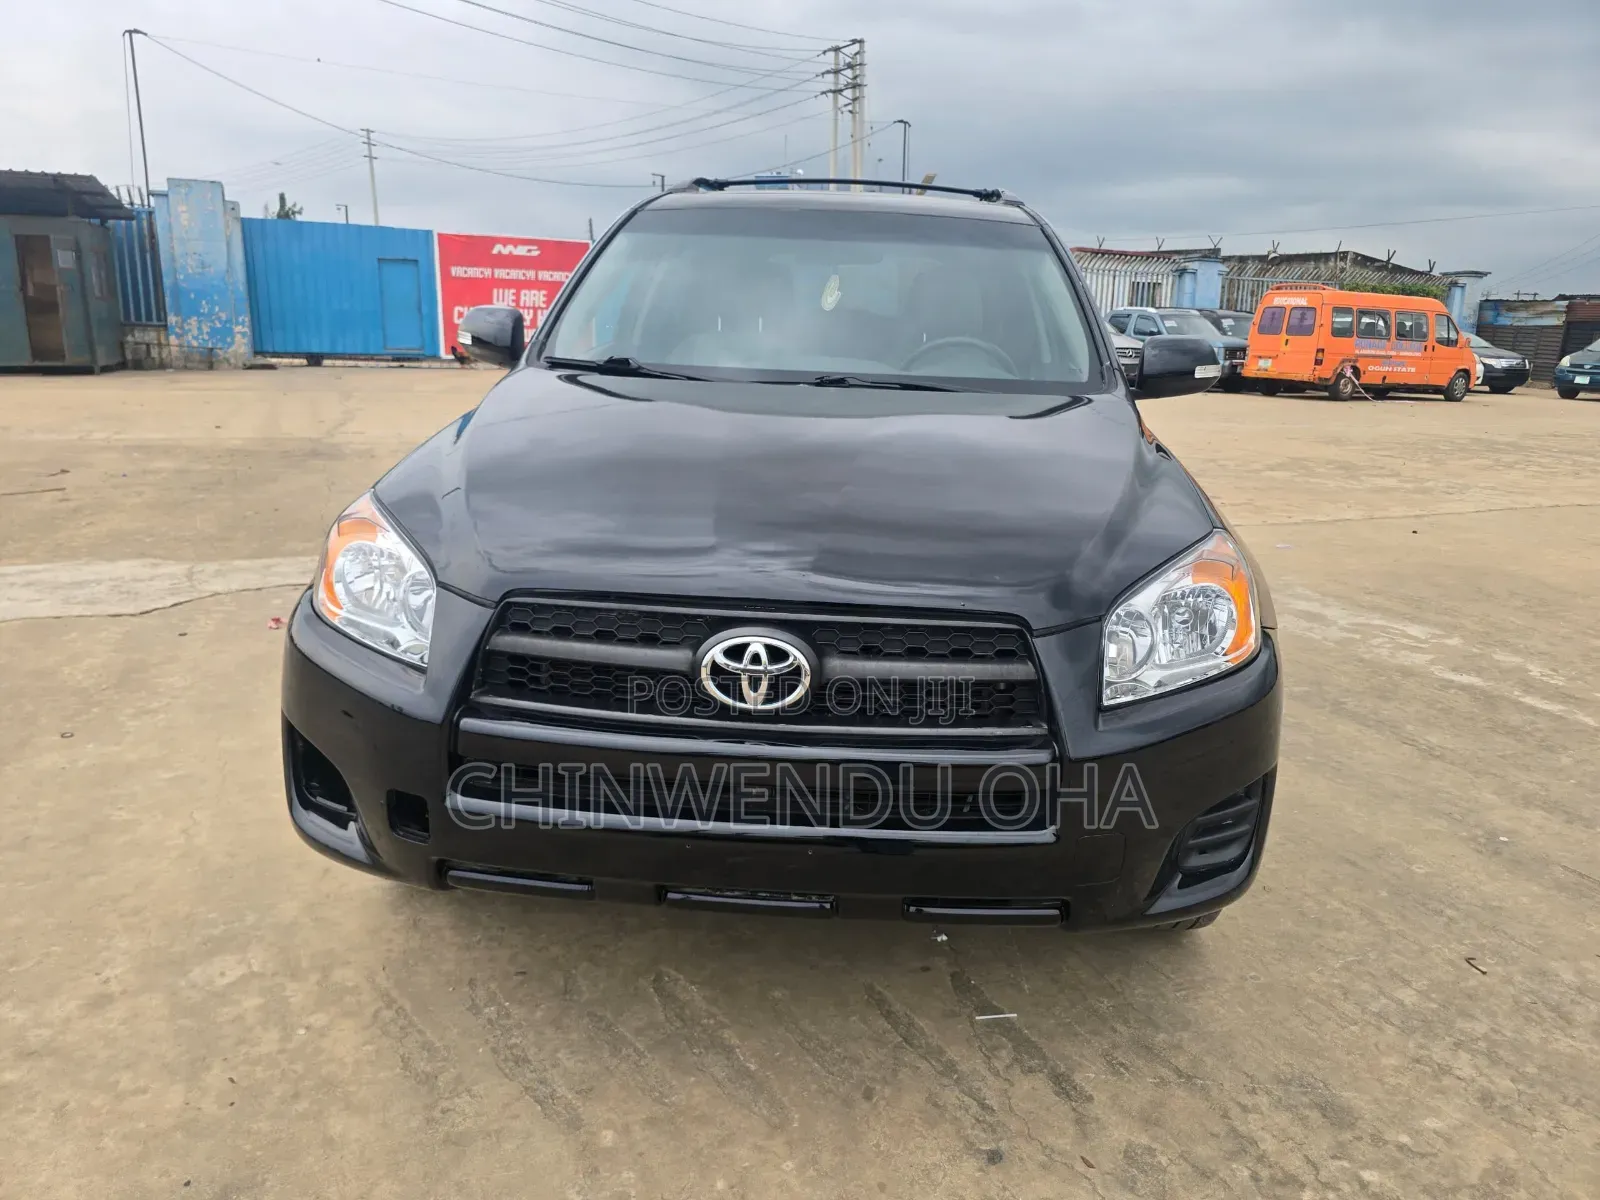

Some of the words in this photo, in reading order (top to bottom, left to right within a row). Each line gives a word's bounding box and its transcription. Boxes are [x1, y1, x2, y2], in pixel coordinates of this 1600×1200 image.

[538, 270, 571, 283] VACANC
[492, 288, 517, 307] WE
[520, 289, 548, 308] ARE
